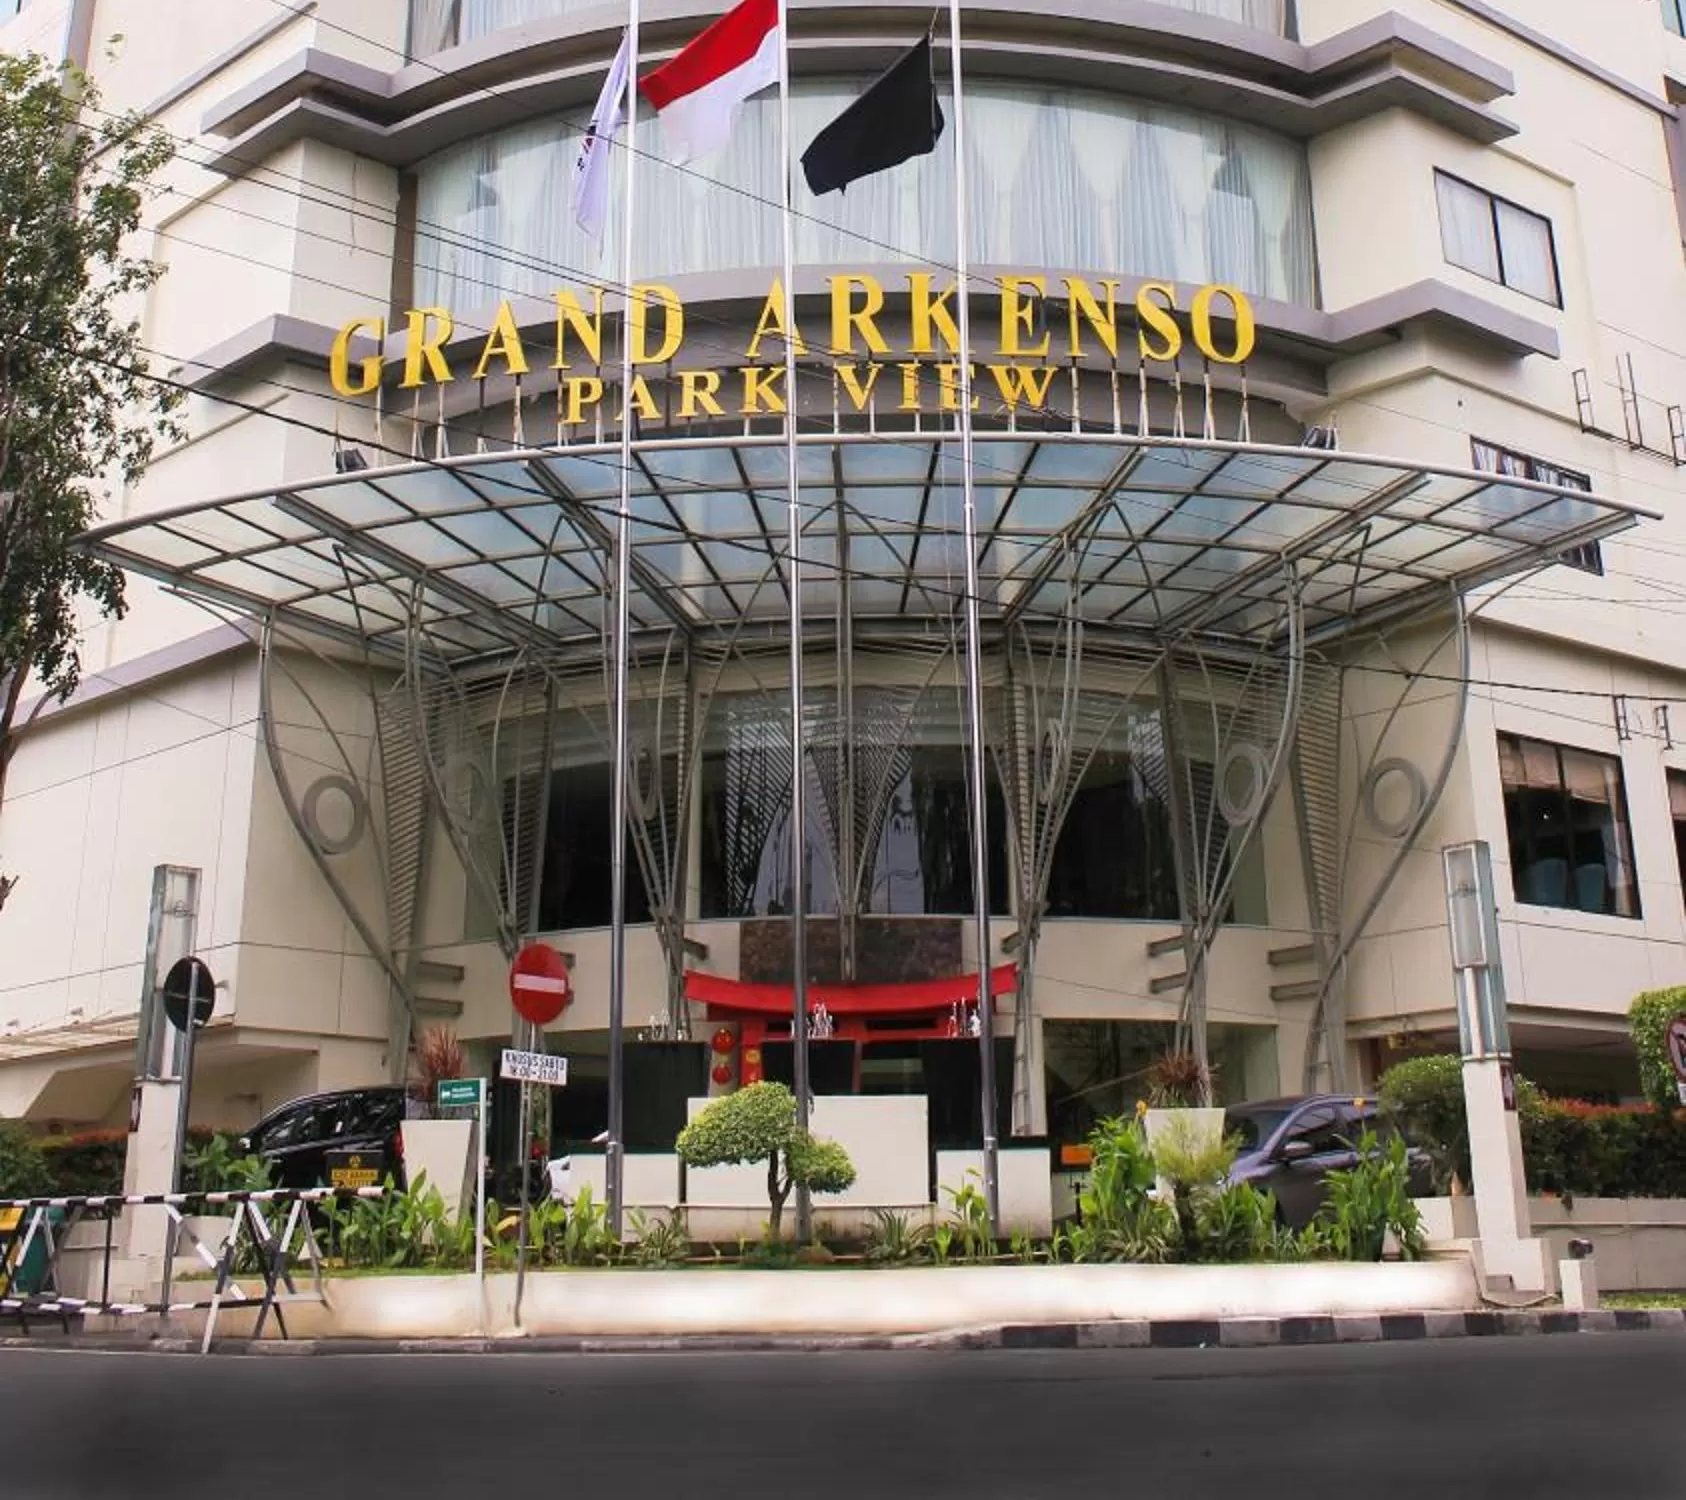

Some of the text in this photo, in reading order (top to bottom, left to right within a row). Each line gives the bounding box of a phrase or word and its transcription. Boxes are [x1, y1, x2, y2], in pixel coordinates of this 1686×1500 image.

[330, 274, 1256, 397] GRAND ARKENSO
[562, 363, 1058, 424] PARK VIEW
